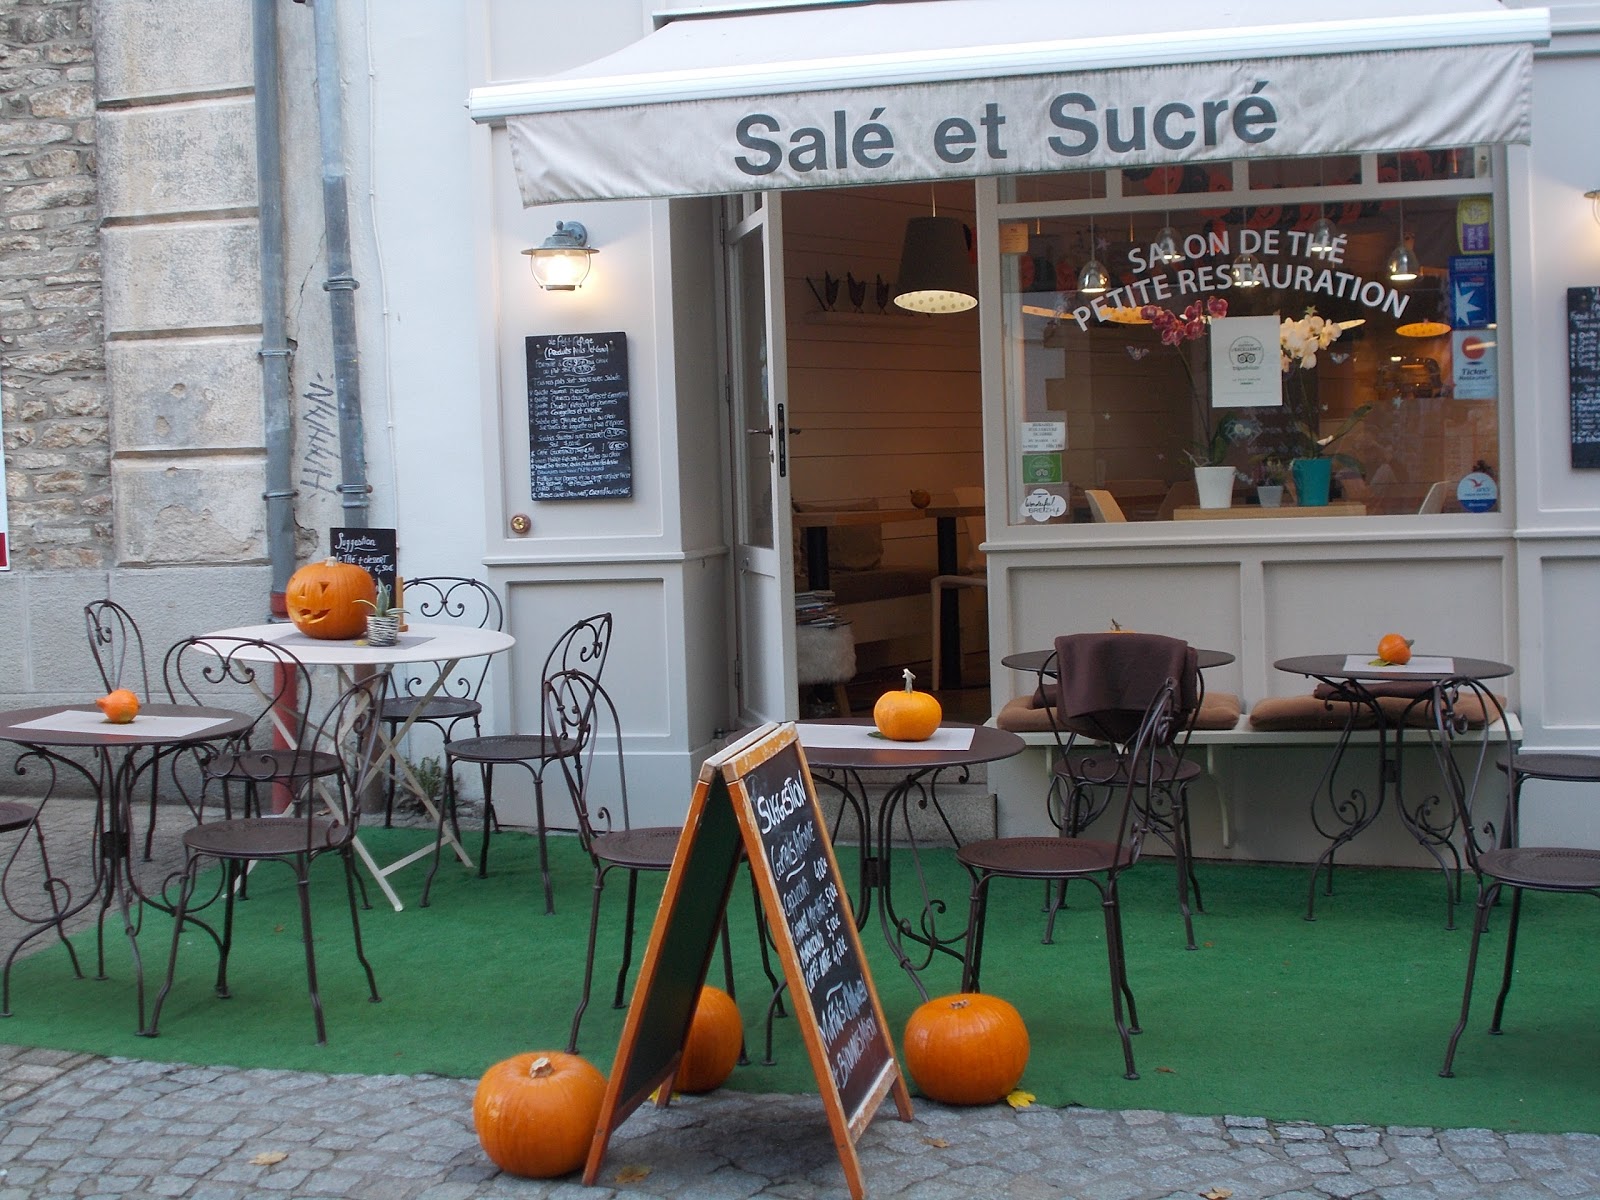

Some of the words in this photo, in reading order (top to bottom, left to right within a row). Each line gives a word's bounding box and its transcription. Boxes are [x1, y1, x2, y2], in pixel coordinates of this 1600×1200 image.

[734, 106, 894, 176] Salé
[934, 102, 1007, 164] et
[1049, 82, 1276, 156] Sucré
[1127, 229, 1233, 275] SALON
[1240, 229, 1283, 256] DE
[1287, 226, 1347, 263] THÉ
[1073, 273, 1172, 332] PETITE
[1180, 263, 1411, 320] RESTAURATION
[1462, 368, 1488, 376] Ticket
[334, 532, 377, 553] Suggestion
[757, 769, 807, 835] SUGGESTION
